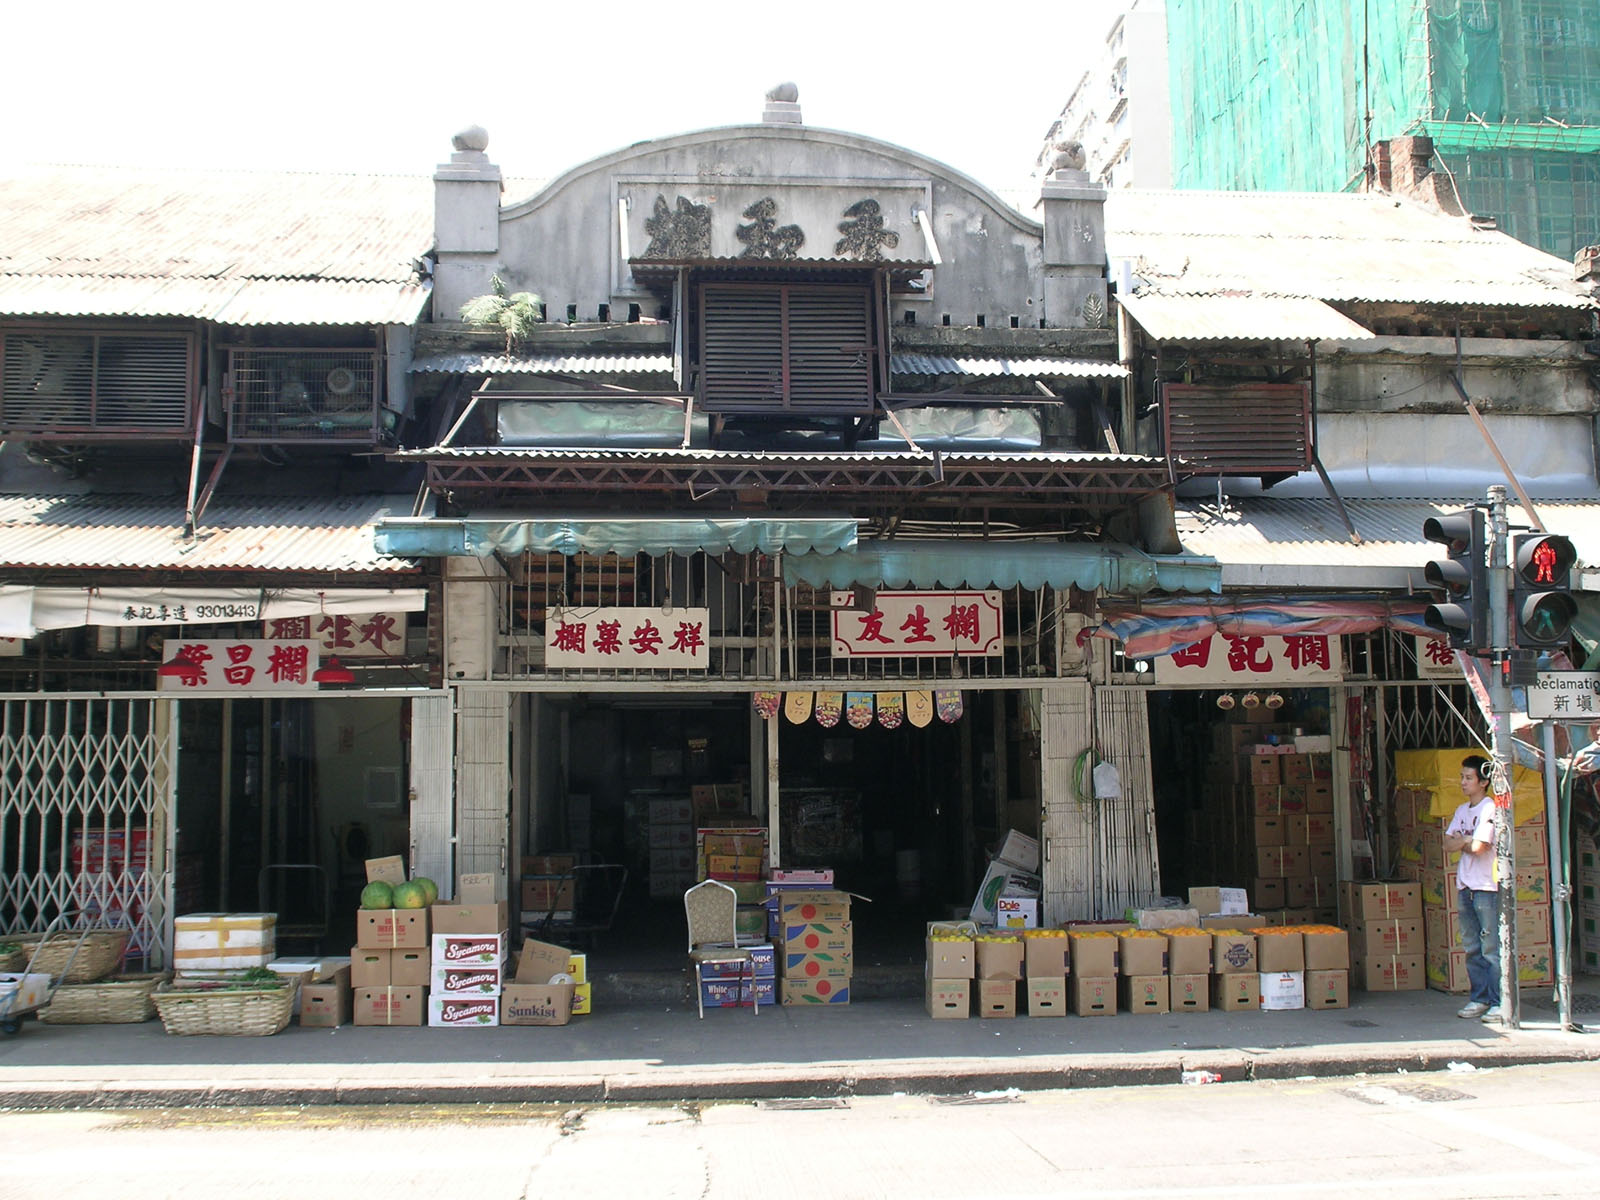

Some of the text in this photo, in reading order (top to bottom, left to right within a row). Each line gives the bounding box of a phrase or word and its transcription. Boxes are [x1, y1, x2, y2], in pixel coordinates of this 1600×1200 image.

[195, 604, 256, 618] 93013413
[999, 900, 1020, 910] Dole
[446, 943, 496, 959] Sycamore
[751, 953, 771, 963] ouse
[446, 973, 495, 989] Sycamore
[708, 984, 728, 994] White
[443, 1005, 492, 1020] Sycamore
[508, 1005, 557, 1018] Sunkist
